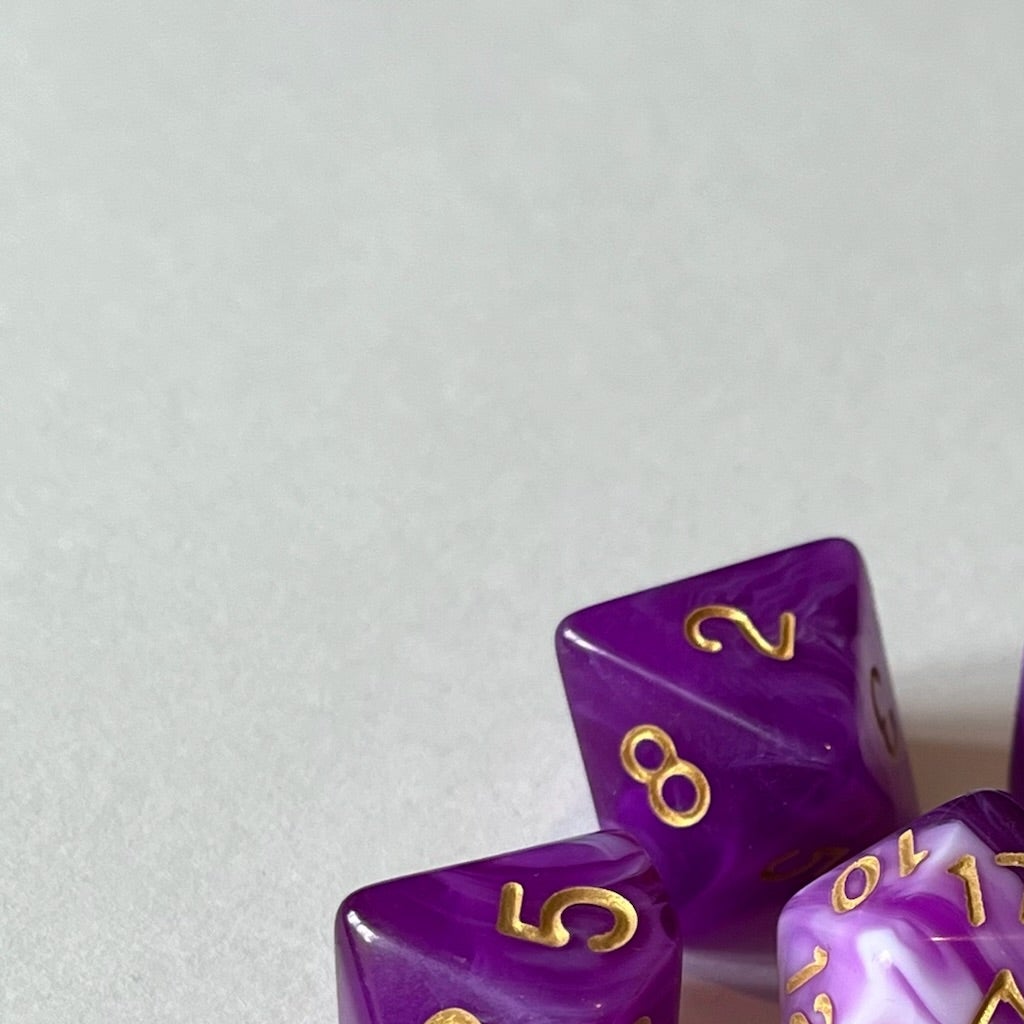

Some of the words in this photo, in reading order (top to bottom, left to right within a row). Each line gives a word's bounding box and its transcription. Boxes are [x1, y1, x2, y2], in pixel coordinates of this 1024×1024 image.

[684, 605, 796, 661] 2
[620, 724, 711, 829] 8
[832, 829, 929, 914] 10
[496, 881, 638, 953] 5
